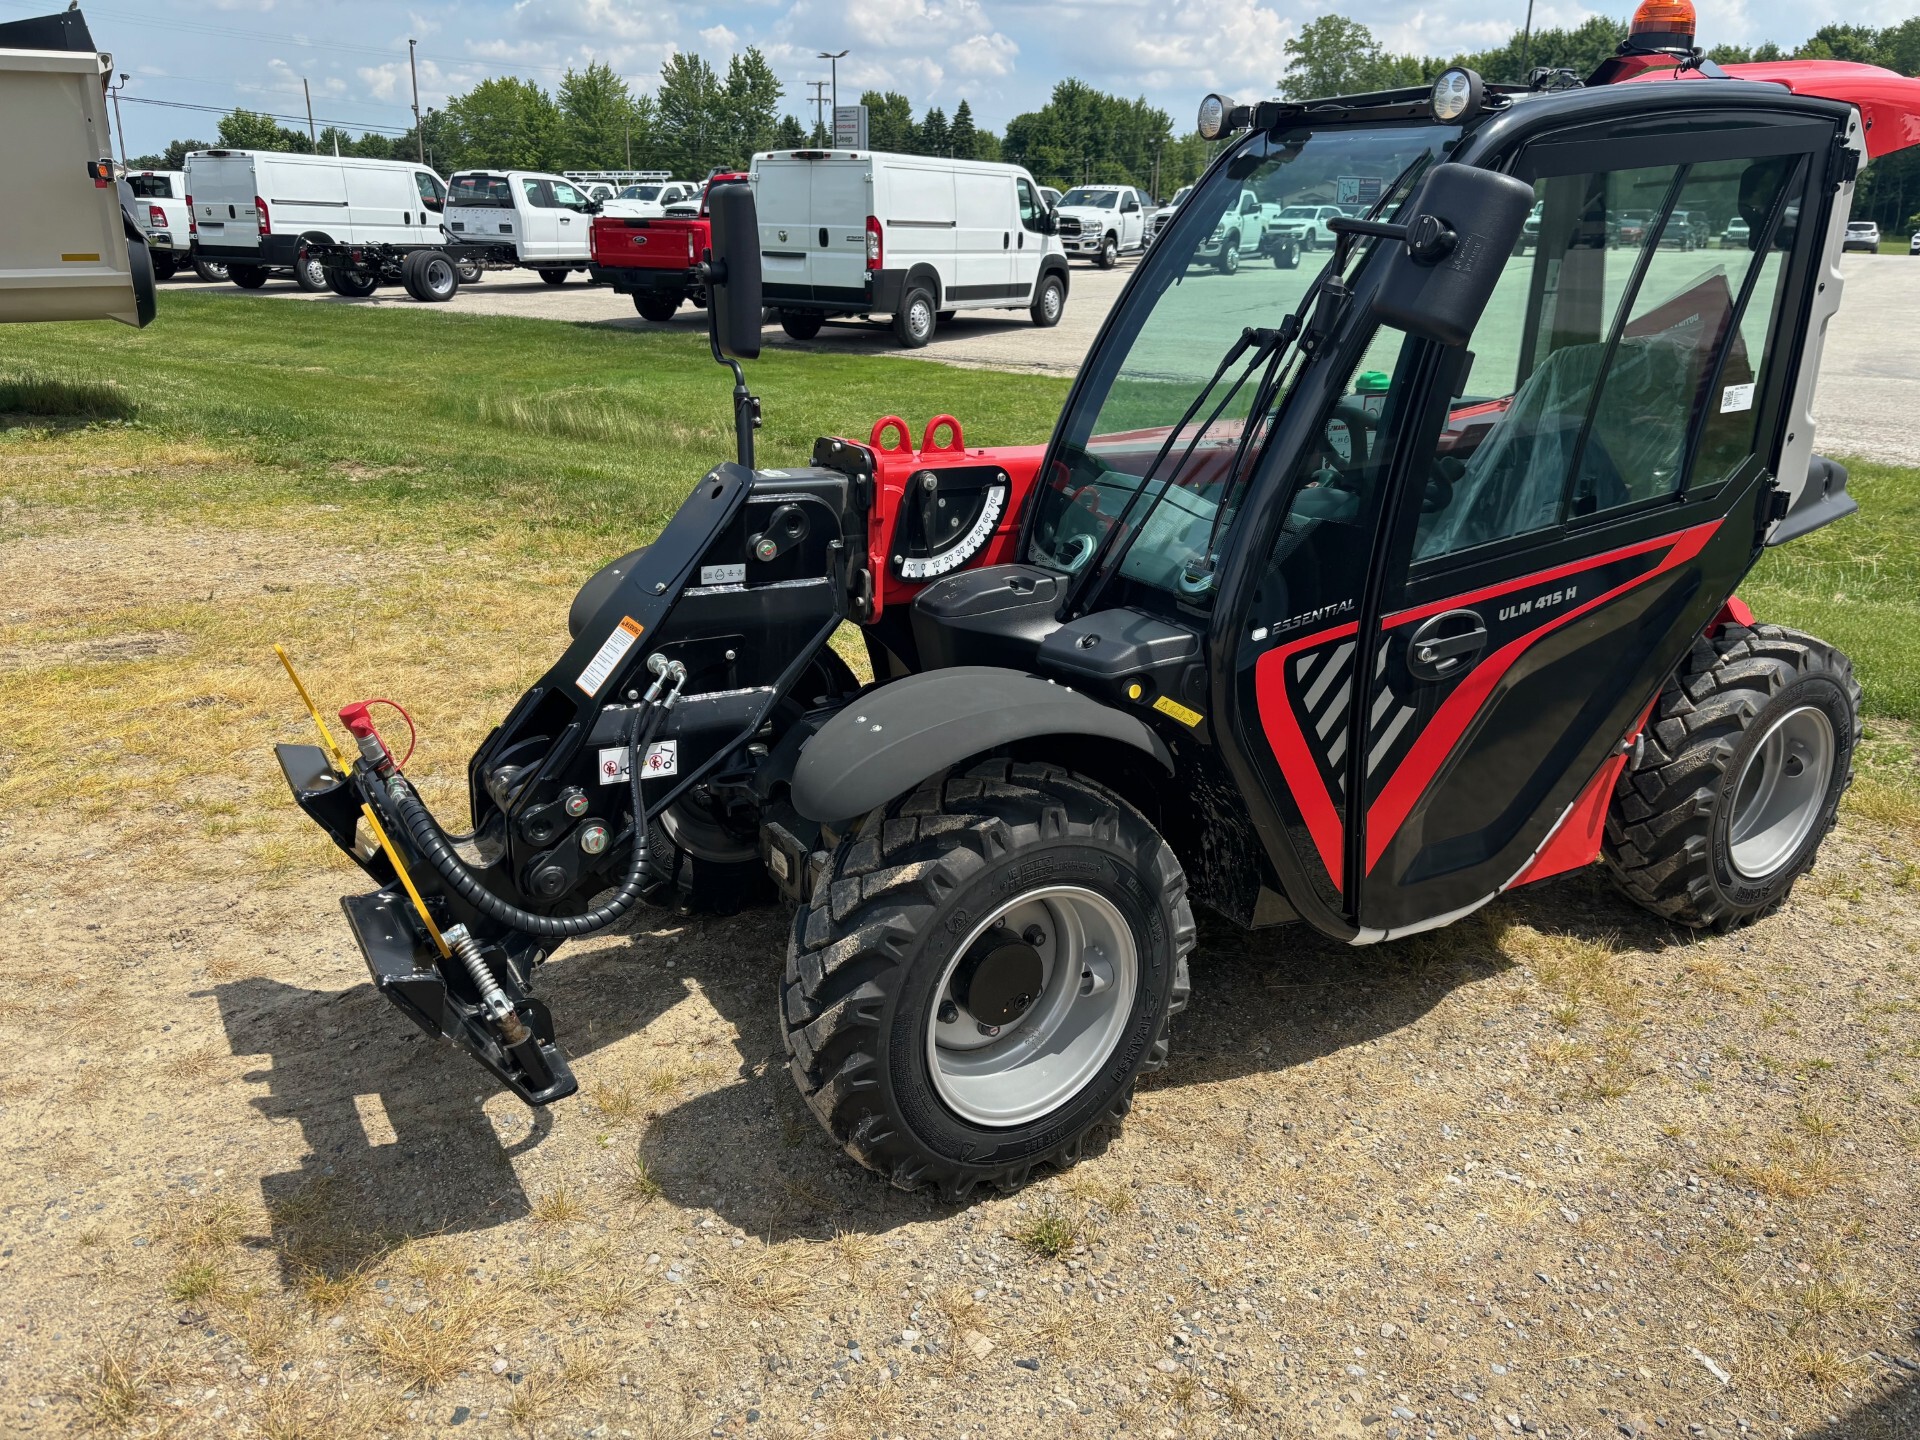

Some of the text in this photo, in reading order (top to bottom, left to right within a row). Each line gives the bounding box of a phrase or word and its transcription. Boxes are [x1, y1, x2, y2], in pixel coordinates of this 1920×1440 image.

[837, 134, 853, 144] Jeep
[1271, 598, 1355, 636] ESSENTIAL
[1498, 585, 1578, 621] ULM 415 H
